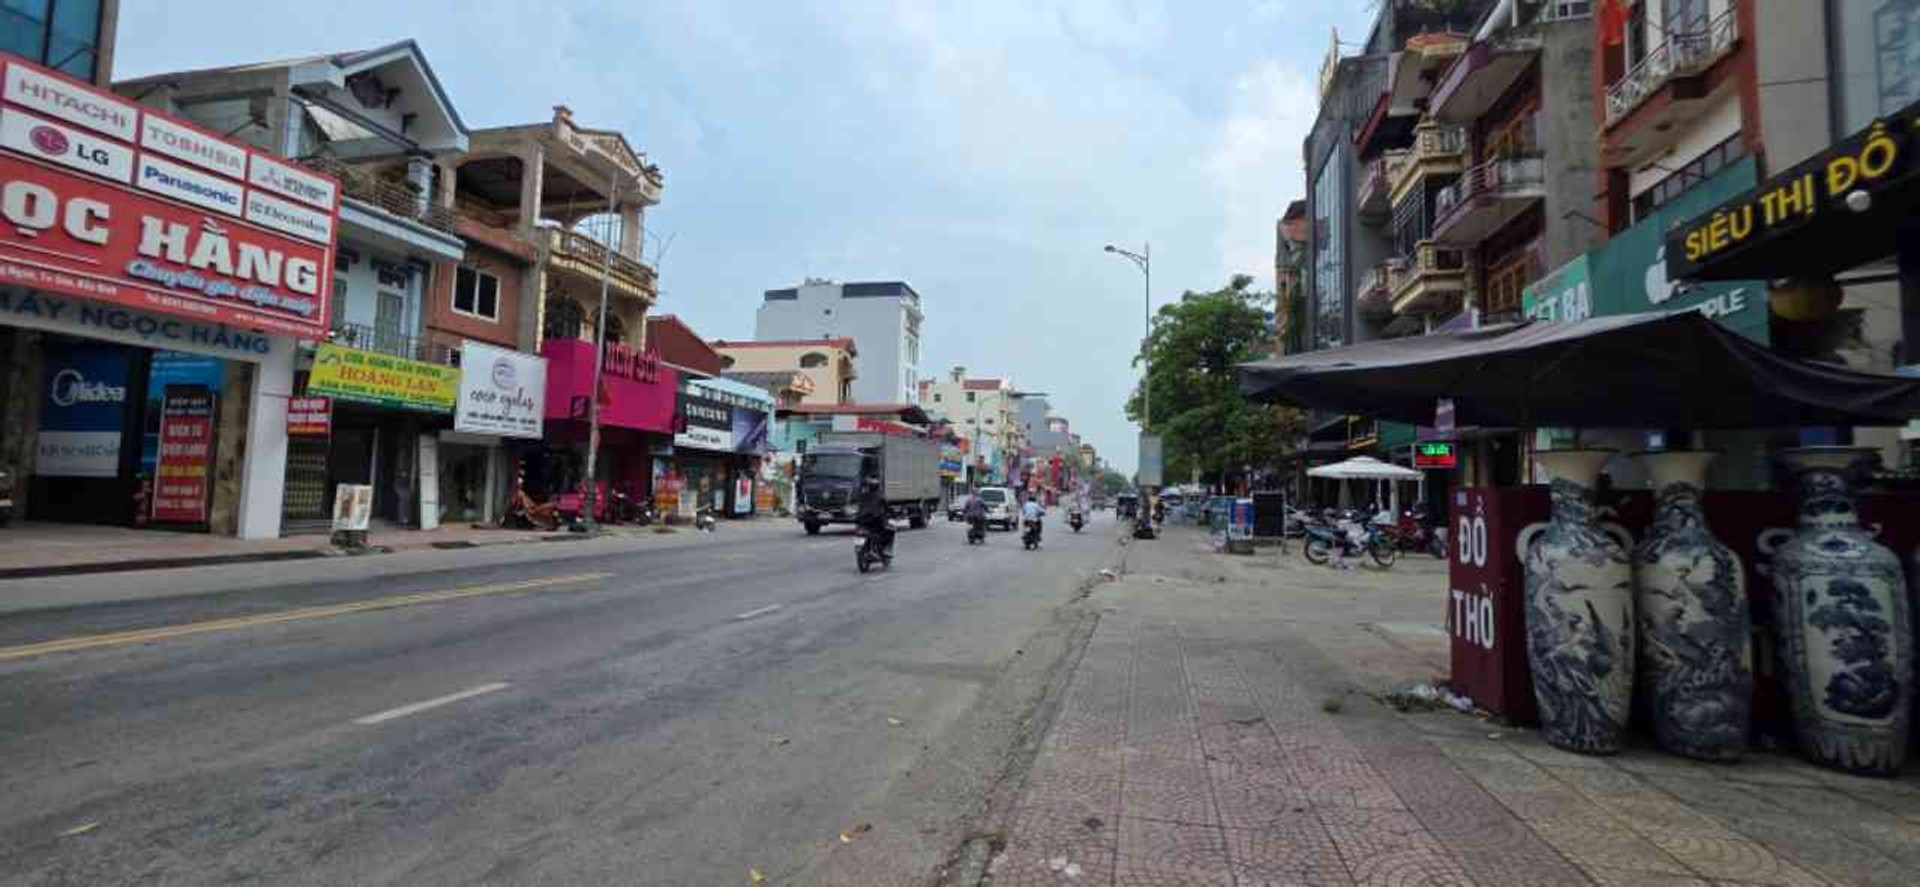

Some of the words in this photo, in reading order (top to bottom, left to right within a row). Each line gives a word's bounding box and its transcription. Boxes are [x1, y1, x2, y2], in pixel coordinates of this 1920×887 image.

[19, 77, 126, 129] HITACHI
[77, 143, 110, 167] LG
[147, 124, 243, 169] TOSHIBA
[144, 164, 238, 206] Panasonic
[1684, 204, 1754, 262] SIÊU
[1762, 173, 1814, 227] THỊ
[1451, 582, 1494, 650] THỜ
